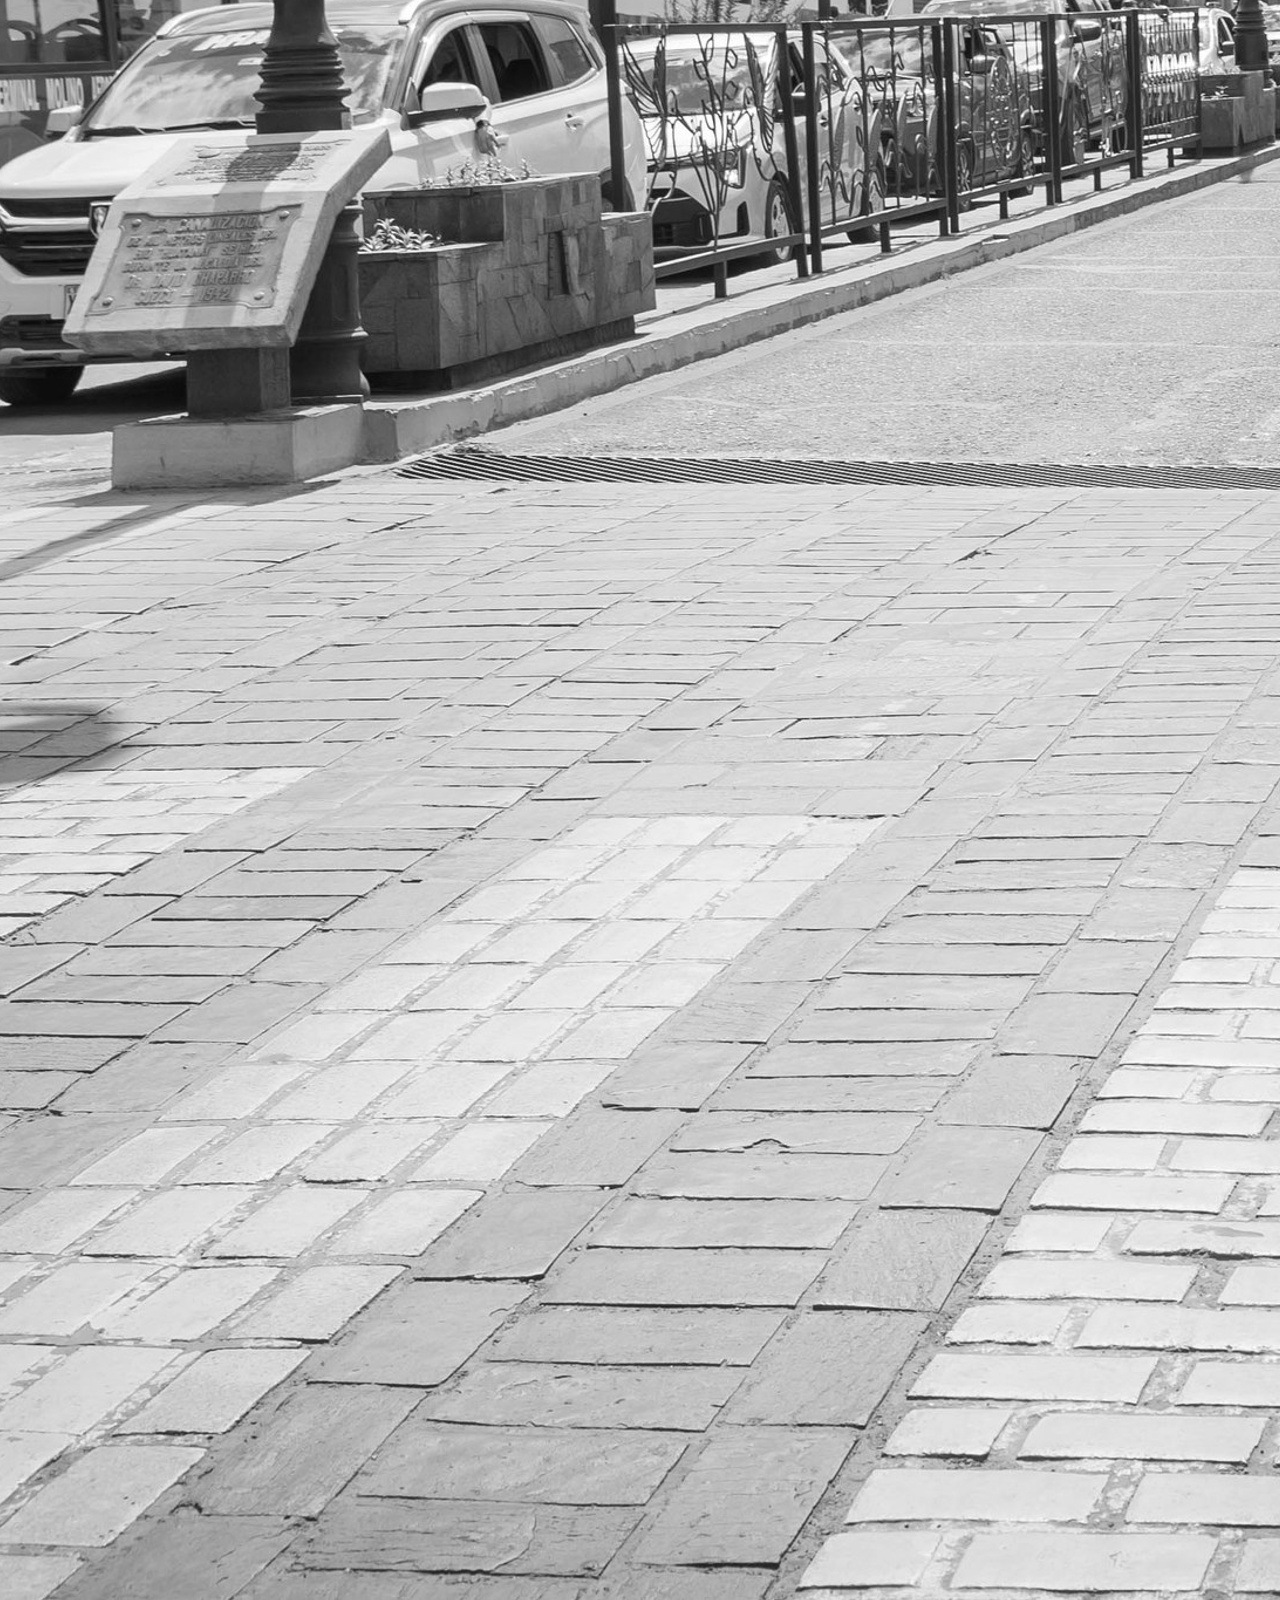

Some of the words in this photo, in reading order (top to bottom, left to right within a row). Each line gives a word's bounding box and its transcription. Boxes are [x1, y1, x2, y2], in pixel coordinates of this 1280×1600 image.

[45, 77, 84, 110] MOLINO
[150, 273, 187, 289] DAVID
[192, 269, 255, 288] CHAPARRO
[197, 285, 234, 303] 1942
